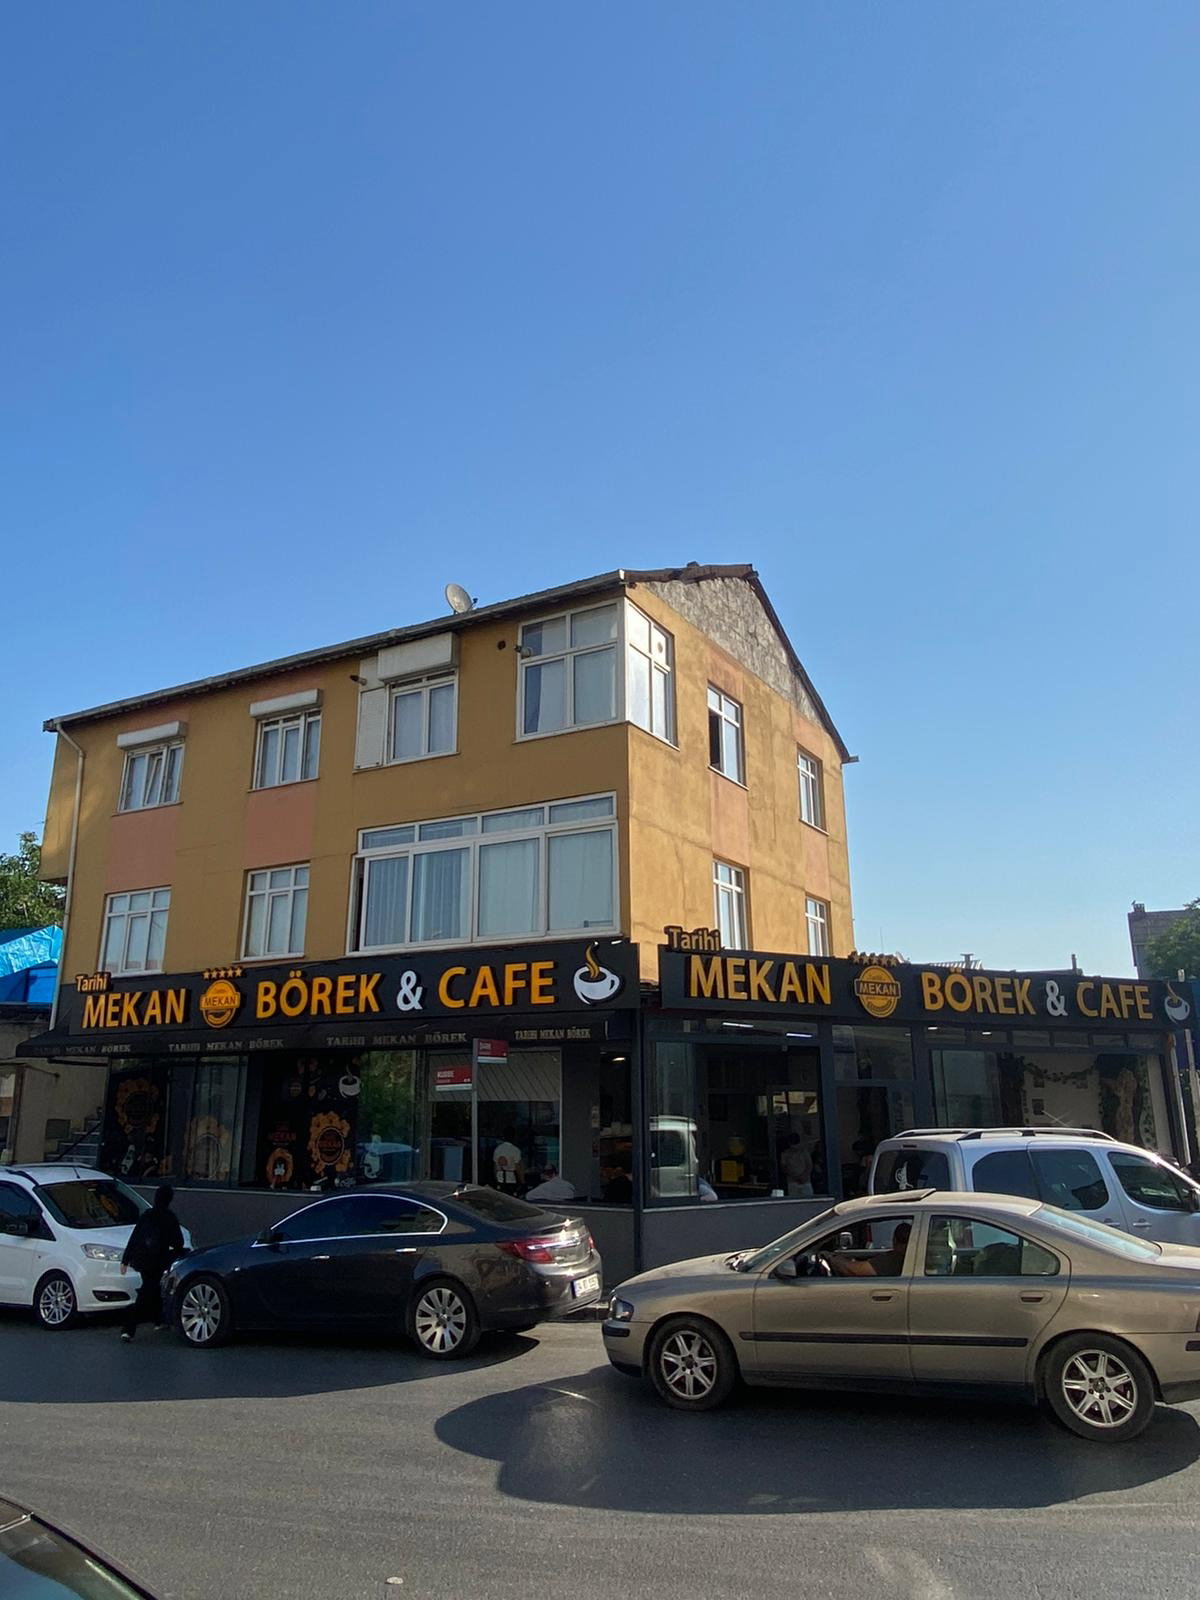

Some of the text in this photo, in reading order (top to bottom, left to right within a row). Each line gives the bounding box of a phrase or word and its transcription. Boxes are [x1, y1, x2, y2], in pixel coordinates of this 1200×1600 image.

[667, 927, 721, 950] Tarihi
[75, 973, 108, 992] Tarihi
[690, 953, 1153, 1020] MEKAN BÖREK & CAFE
[859, 982, 896, 996] MEKAN
[82, 960, 556, 1029] MEKAN BÖREK & CAFE
[204, 994, 236, 1007] MEKAN
